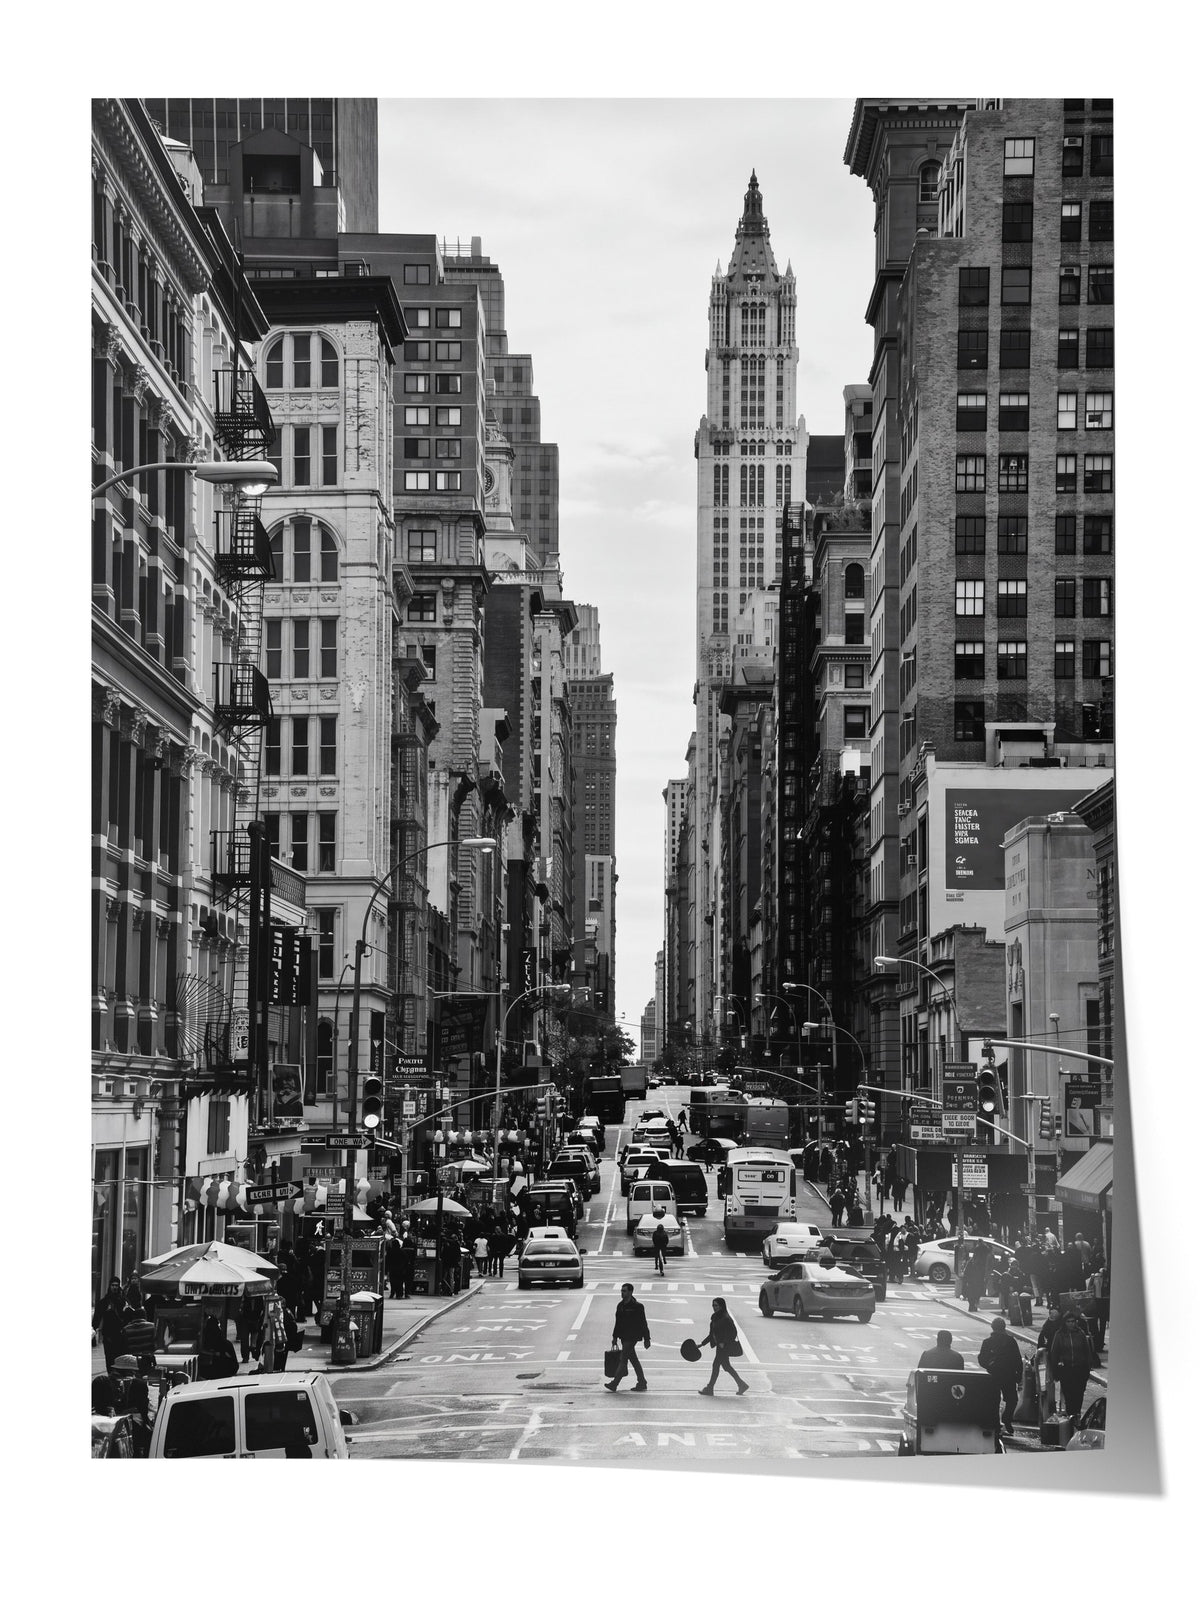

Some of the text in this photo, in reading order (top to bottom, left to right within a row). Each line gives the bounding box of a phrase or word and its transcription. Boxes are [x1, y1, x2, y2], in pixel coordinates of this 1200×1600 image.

[451, 1323, 548, 1333] ONLY
[777, 1343, 875, 1353] ONLY
[420, 1351, 535, 1364] ONLY
[788, 1352, 880, 1364] BUS
